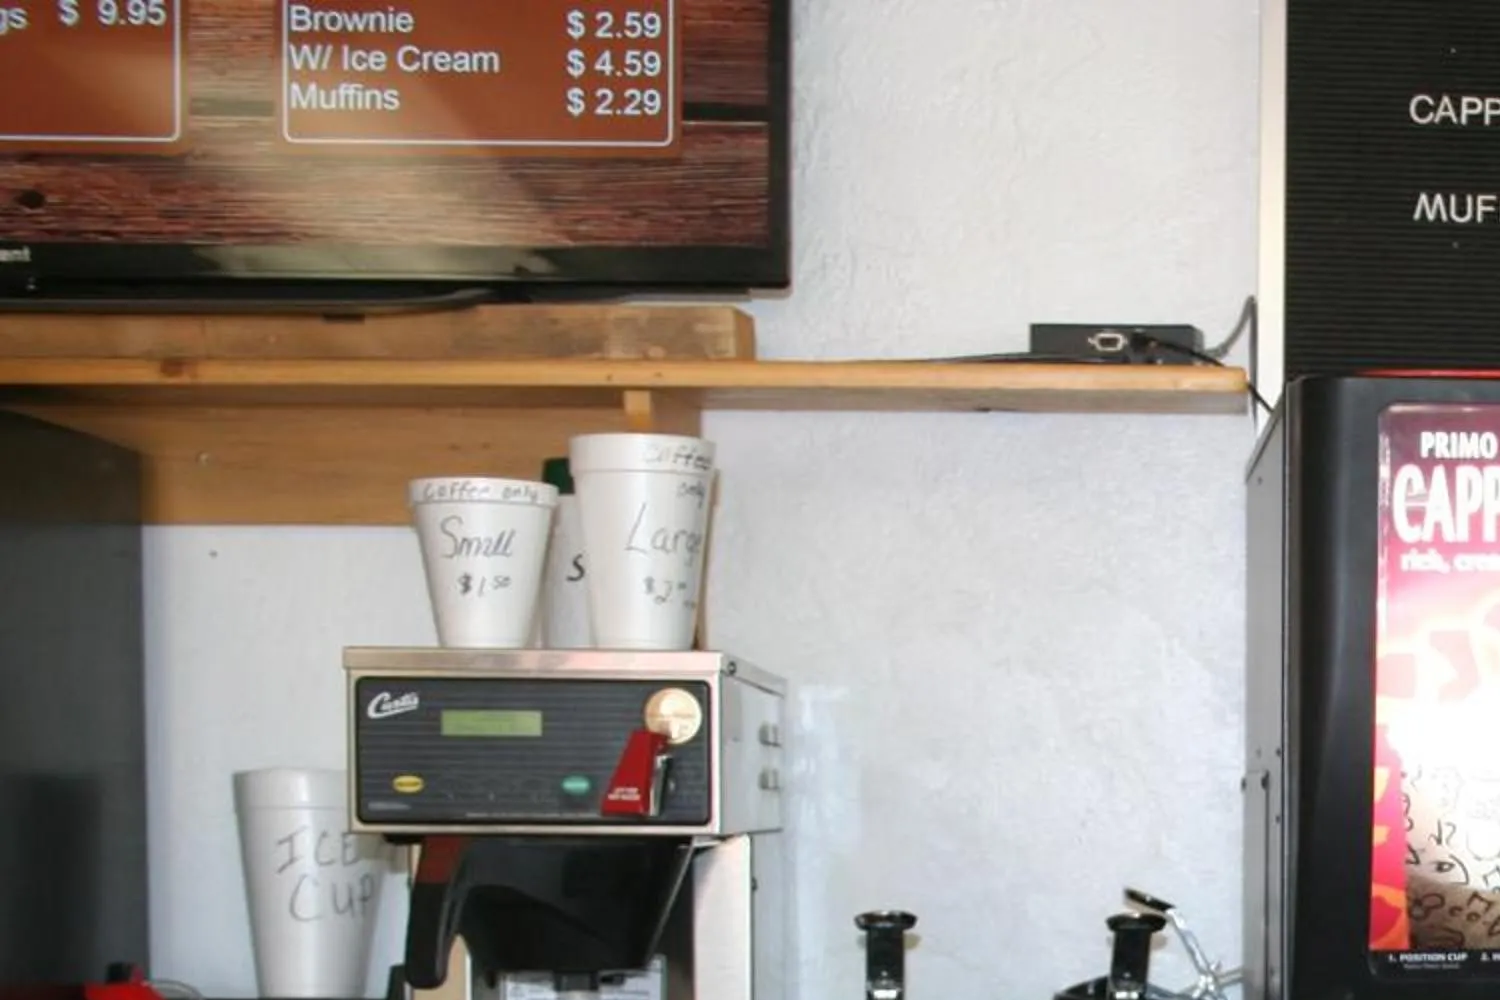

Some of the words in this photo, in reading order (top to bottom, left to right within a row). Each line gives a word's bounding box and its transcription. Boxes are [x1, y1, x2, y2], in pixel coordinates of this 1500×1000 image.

[98, 0, 166, 26] 9.95
[290, 5, 414, 33] Brownie
[566, 9, 586, 40] $
[594, 11, 661, 38] 2.59
[289, 45, 332, 71] W/
[342, 45, 388, 71] Ice
[397, 45, 500, 73] Cream
[566, 48, 586, 78] $
[594, 49, 661, 76] 4.59
[290, 82, 400, 110] Muffins
[566, 87, 586, 117] $
[594, 88, 661, 115] 2.29
[1420, 431, 1498, 460] PRIMO
[440, 514, 517, 560] Small
[276, 826, 361, 874] ICE
